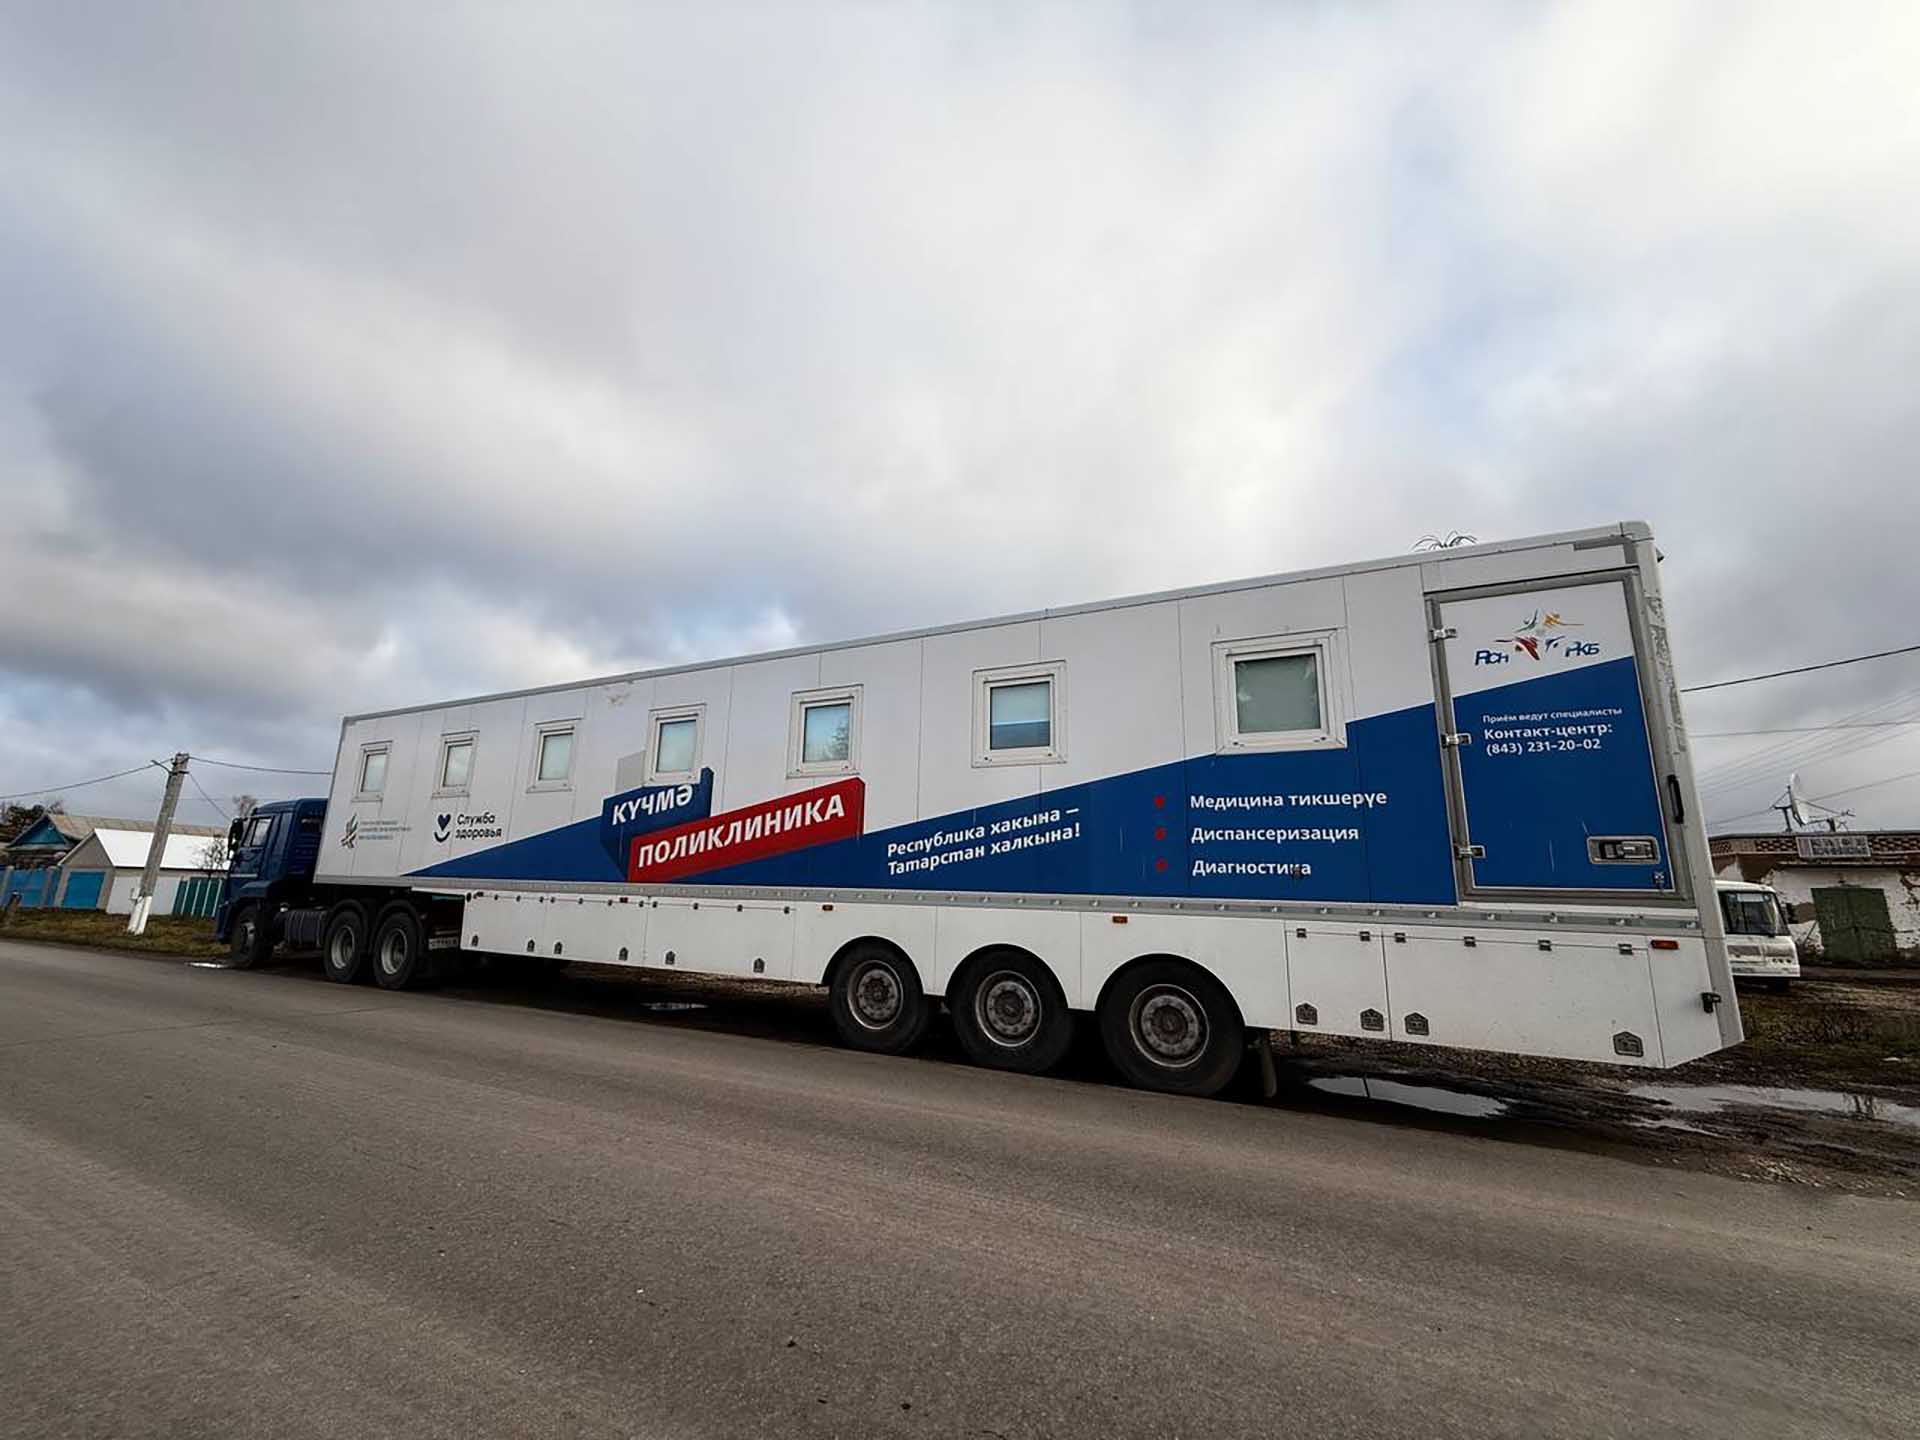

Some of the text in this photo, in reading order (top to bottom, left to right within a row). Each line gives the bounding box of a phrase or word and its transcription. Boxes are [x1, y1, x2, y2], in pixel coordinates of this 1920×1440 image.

[1519, 712, 1548, 722] ведут
[1550, 708, 1622, 719] специалисты
[1484, 723, 1613, 740] Контакт-центр:
[1486, 738, 1601, 756] (843) 231-20-02
[1190, 795, 1284, 811] Медицина
[457, 812, 495, 828] Служба
[455, 827, 502, 840] здоровья
[638, 794, 845, 868] ПОЛИКЛИНИКА
[887, 825, 985, 857] Республика
[990, 809, 1060, 836] хакына
[1191, 827, 1359, 844] Диспансеризация
[888, 822, 1080, 875] Татарстан халкына!
